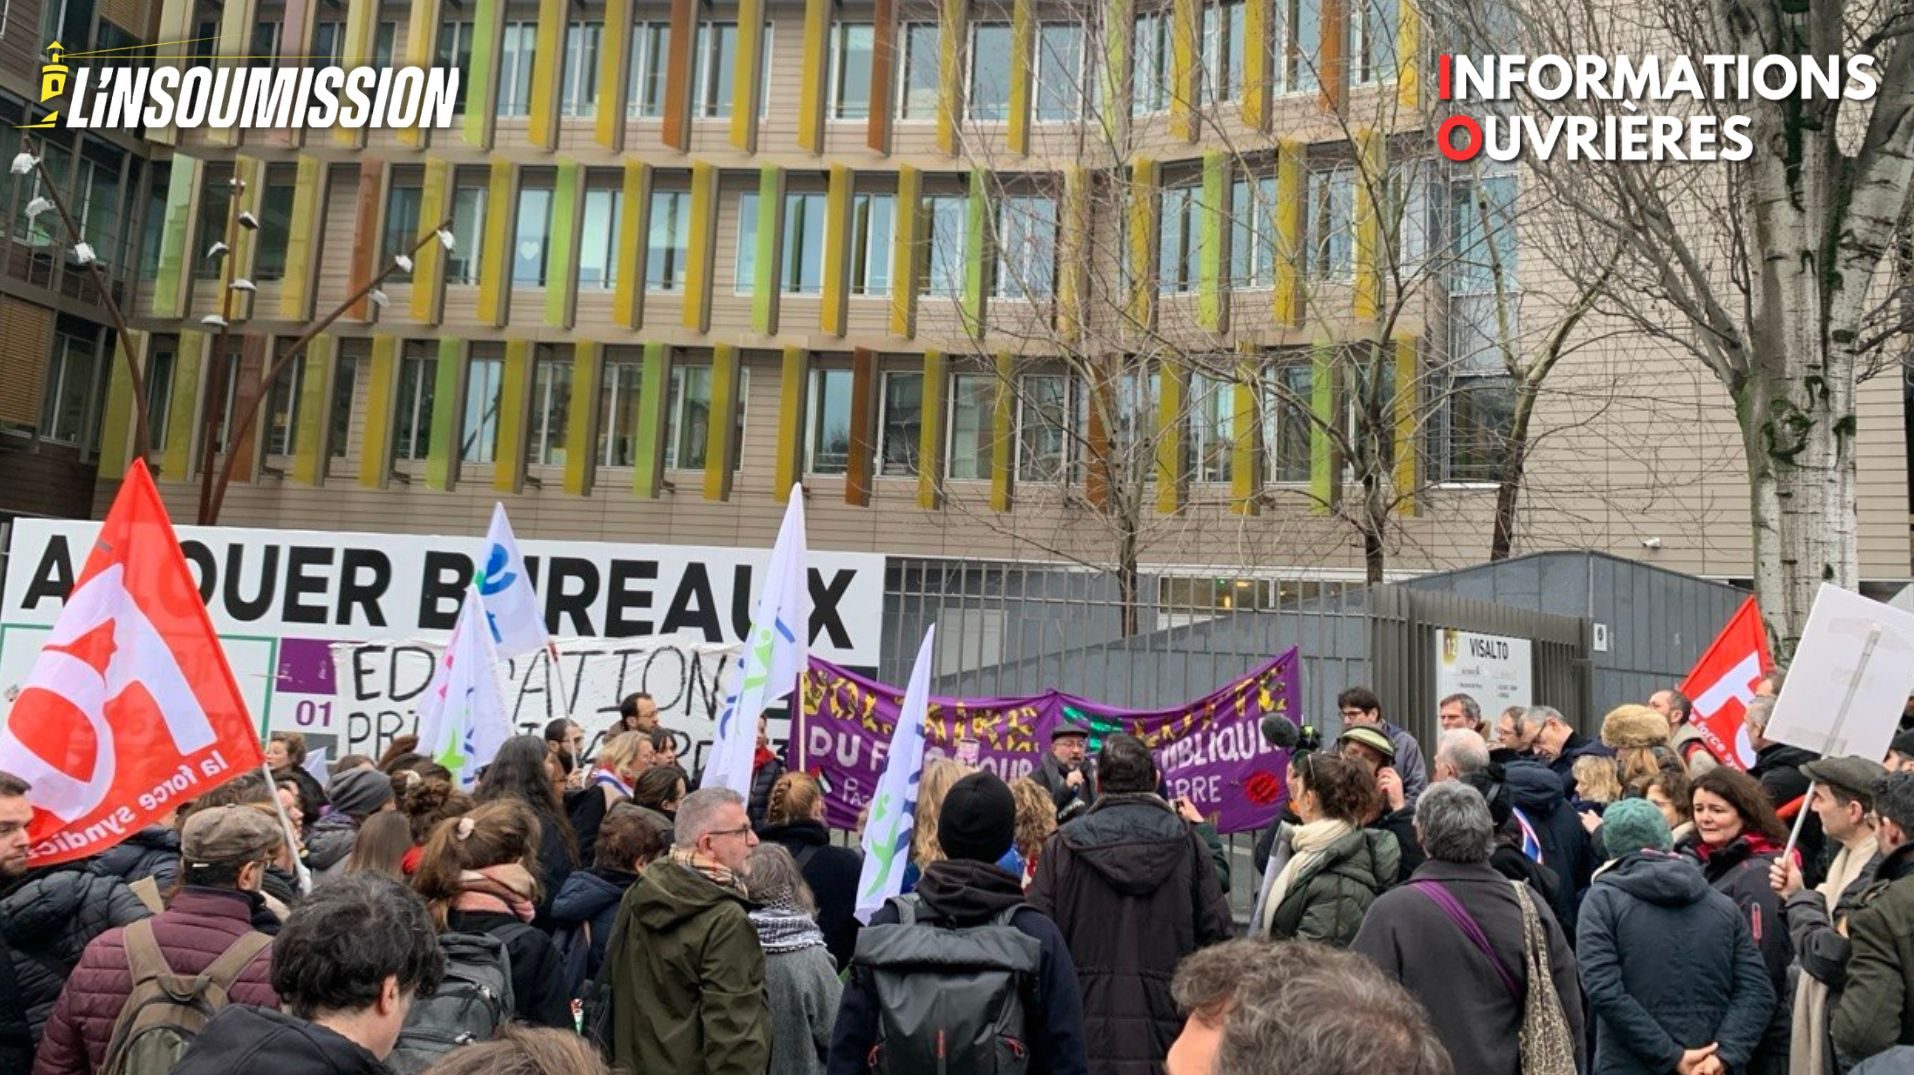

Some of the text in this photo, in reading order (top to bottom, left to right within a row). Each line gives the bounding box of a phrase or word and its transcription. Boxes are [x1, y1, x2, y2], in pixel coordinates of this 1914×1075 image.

[20, 535, 75, 609] A
[158, 539, 391, 627] OUER
[1469, 638, 1509, 660] VISALTO
[352, 645, 728, 723] EDATION
[296, 700, 331, 727] 01
[809, 726, 861, 767] DU
